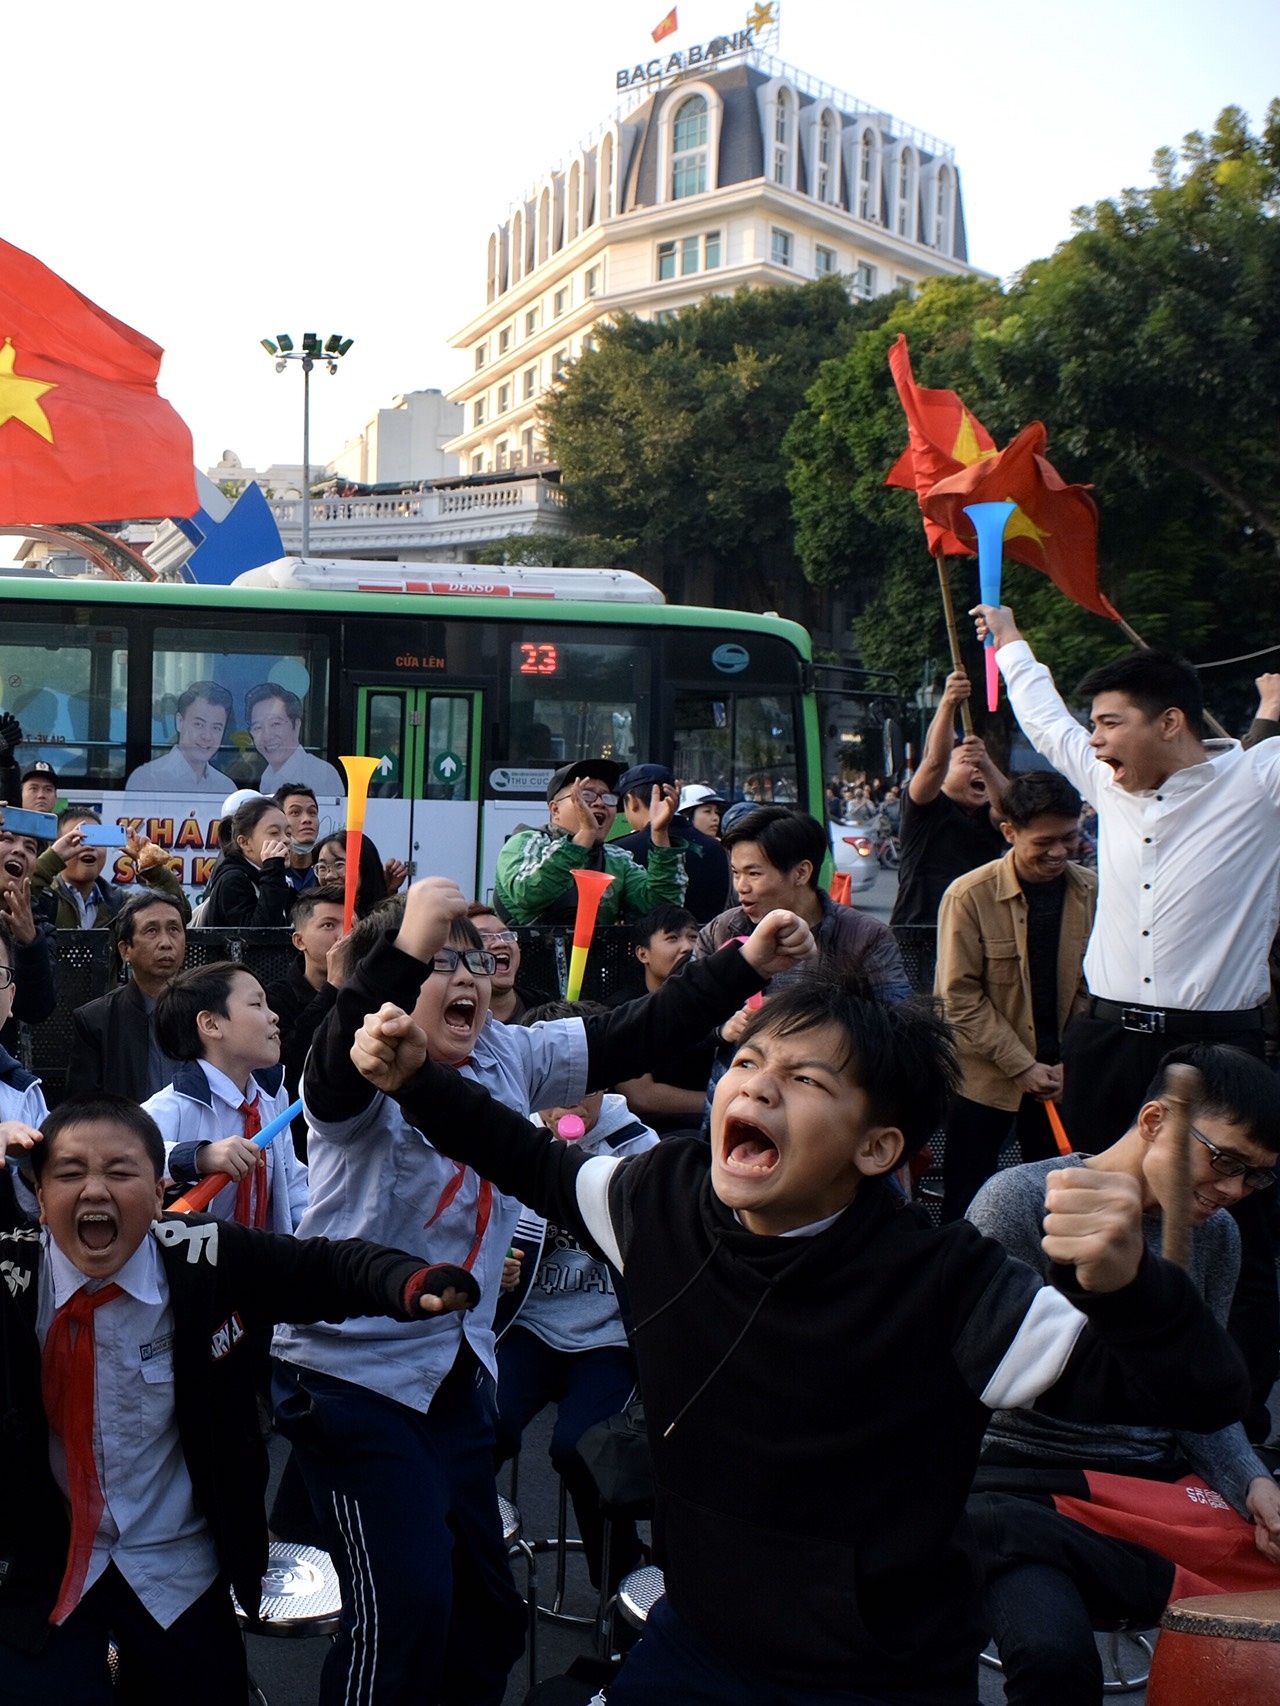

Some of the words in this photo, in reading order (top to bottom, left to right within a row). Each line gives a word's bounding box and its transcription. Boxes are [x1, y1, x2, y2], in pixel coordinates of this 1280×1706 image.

[616, 58, 661, 89] BAC
[666, 52, 682, 73] A
[688, 26, 757, 66] BANK
[449, 583, 495, 593] DENSO
[395, 653, 419, 668] CỬA
[422, 655, 445, 669] LÊN
[520, 644, 557, 674] 23
[511, 777, 528, 785] THU
[111, 855, 184, 884] SC
[532, 1262, 615, 1296] QUA
